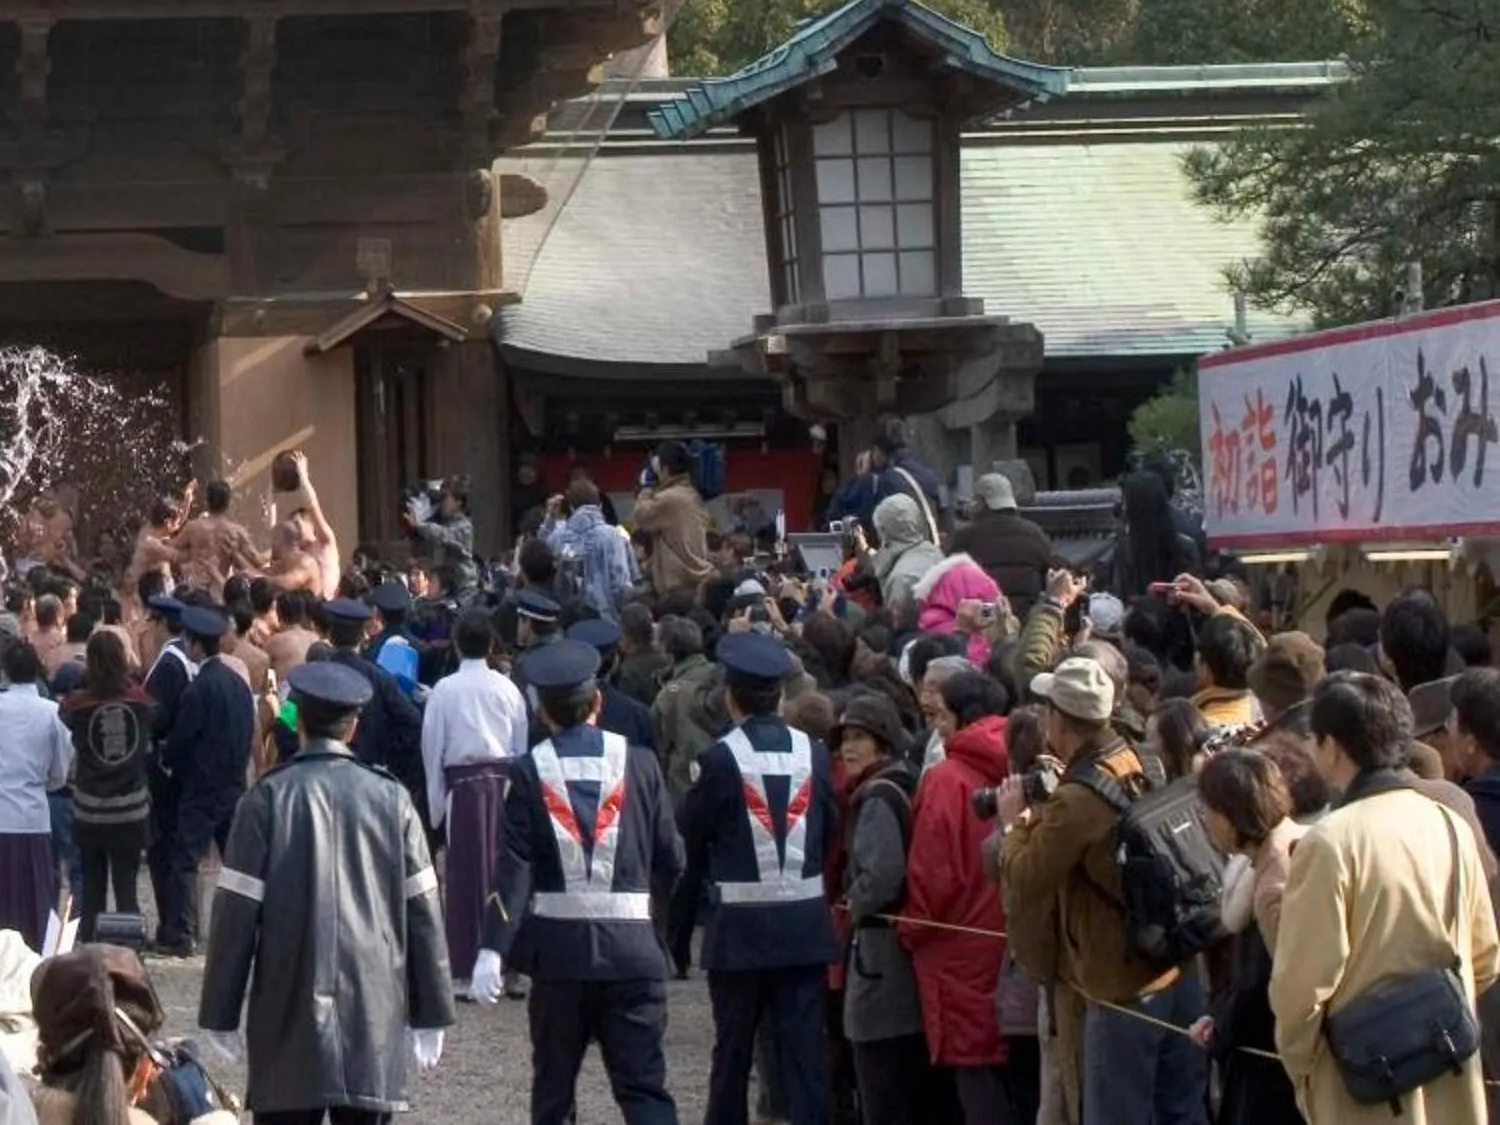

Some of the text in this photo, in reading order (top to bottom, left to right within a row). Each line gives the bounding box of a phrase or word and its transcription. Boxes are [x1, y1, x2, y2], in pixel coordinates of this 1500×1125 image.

[1209, 347, 1498, 524] 初詣 御守り おみ
